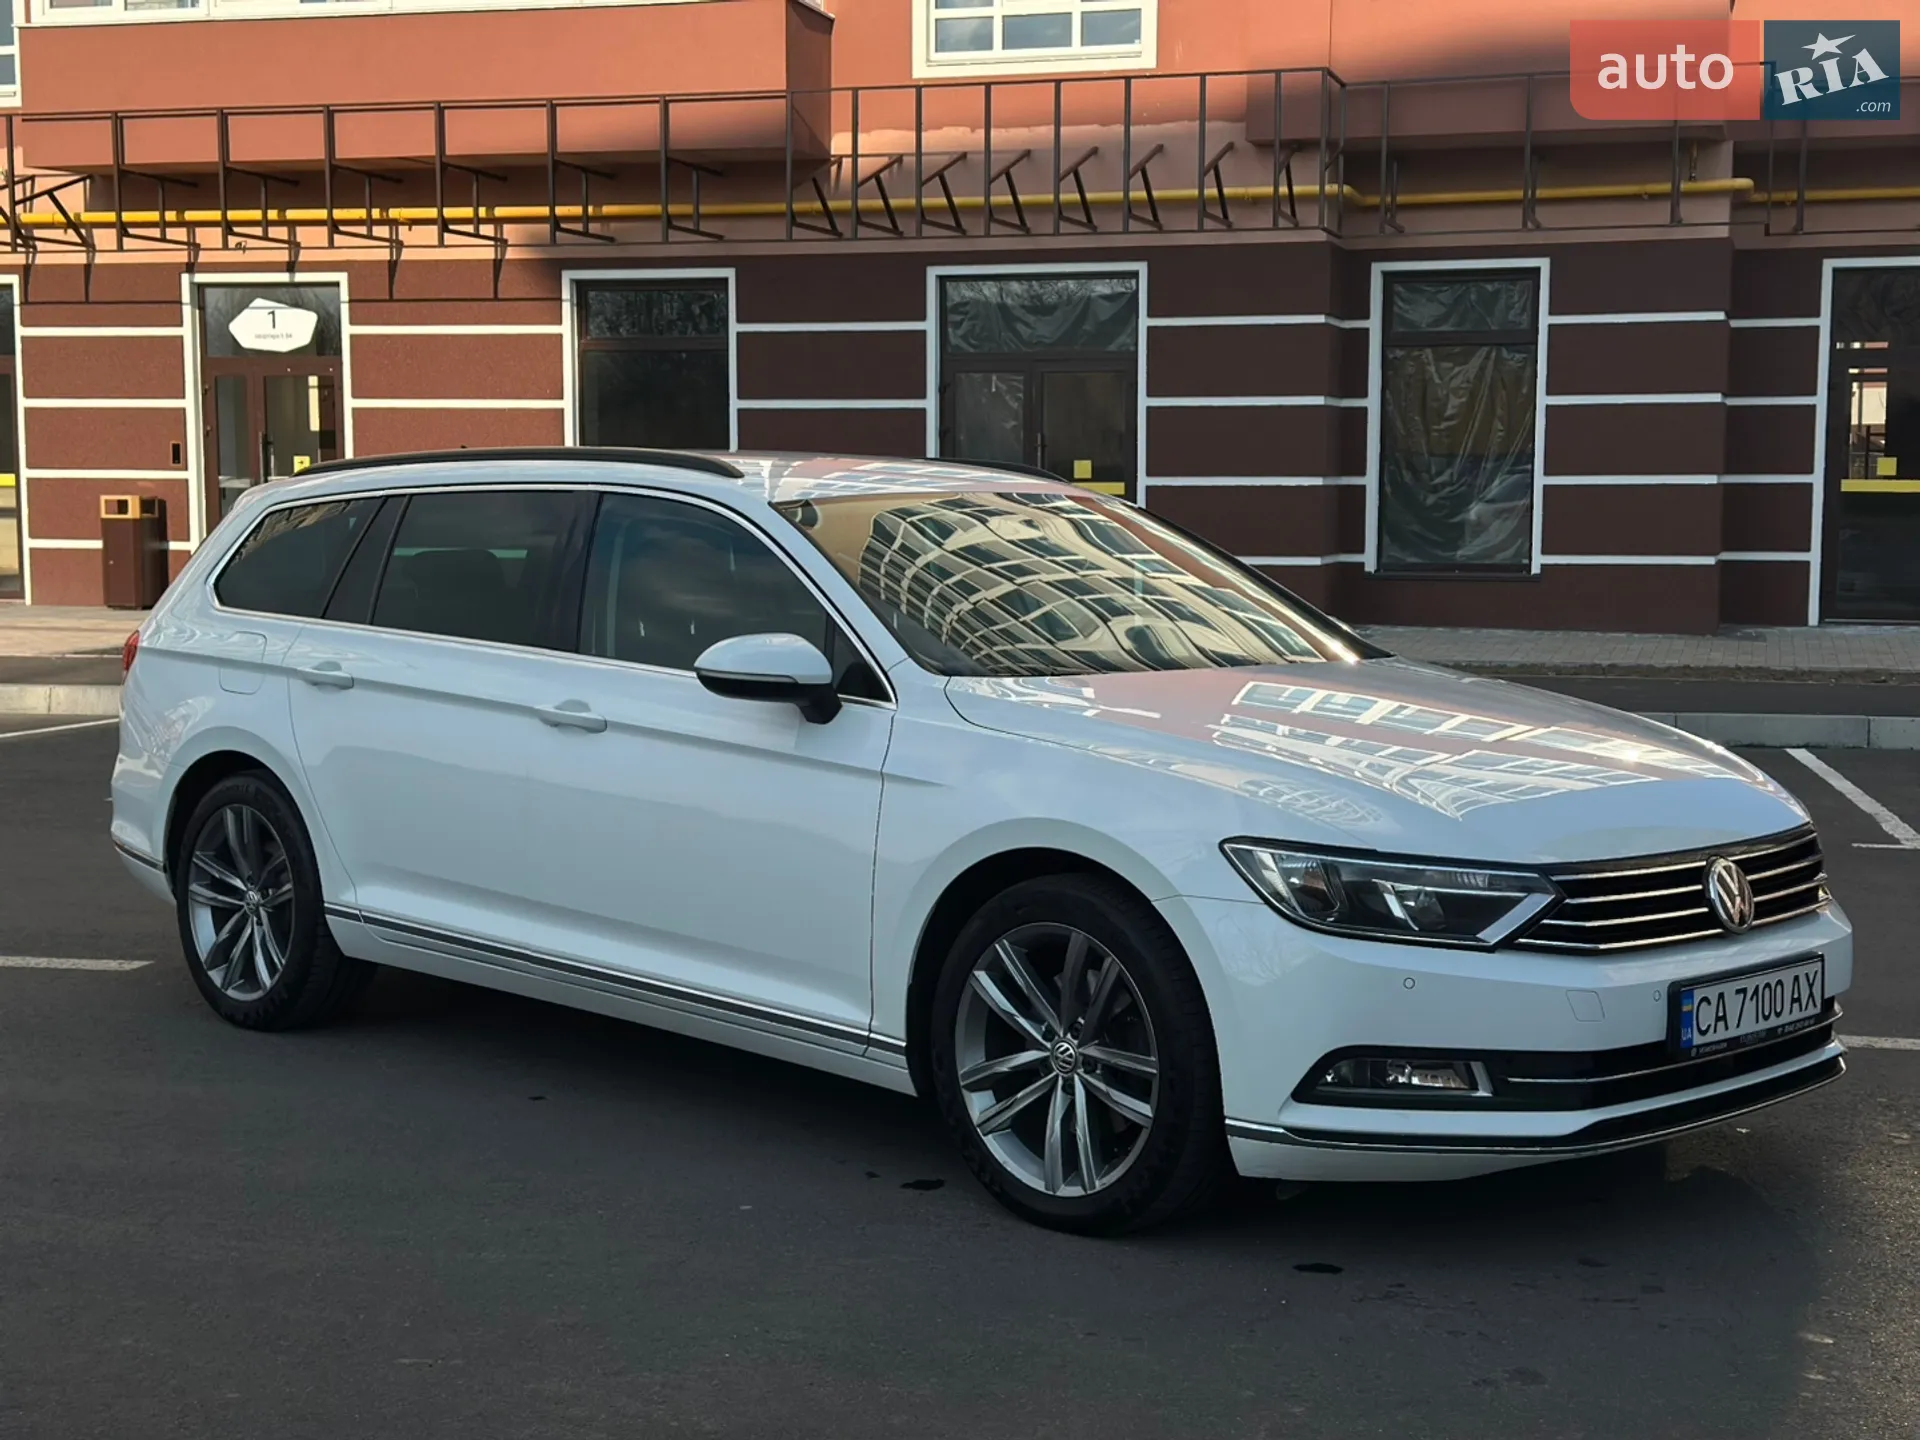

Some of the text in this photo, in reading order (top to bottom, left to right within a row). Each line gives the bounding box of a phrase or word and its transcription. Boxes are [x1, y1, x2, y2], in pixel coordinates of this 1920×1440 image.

[267, 310, 276, 330] 1
[1695, 969, 1819, 1037] CA 7100 AX
[1681, 1027, 1692, 1041] UA
